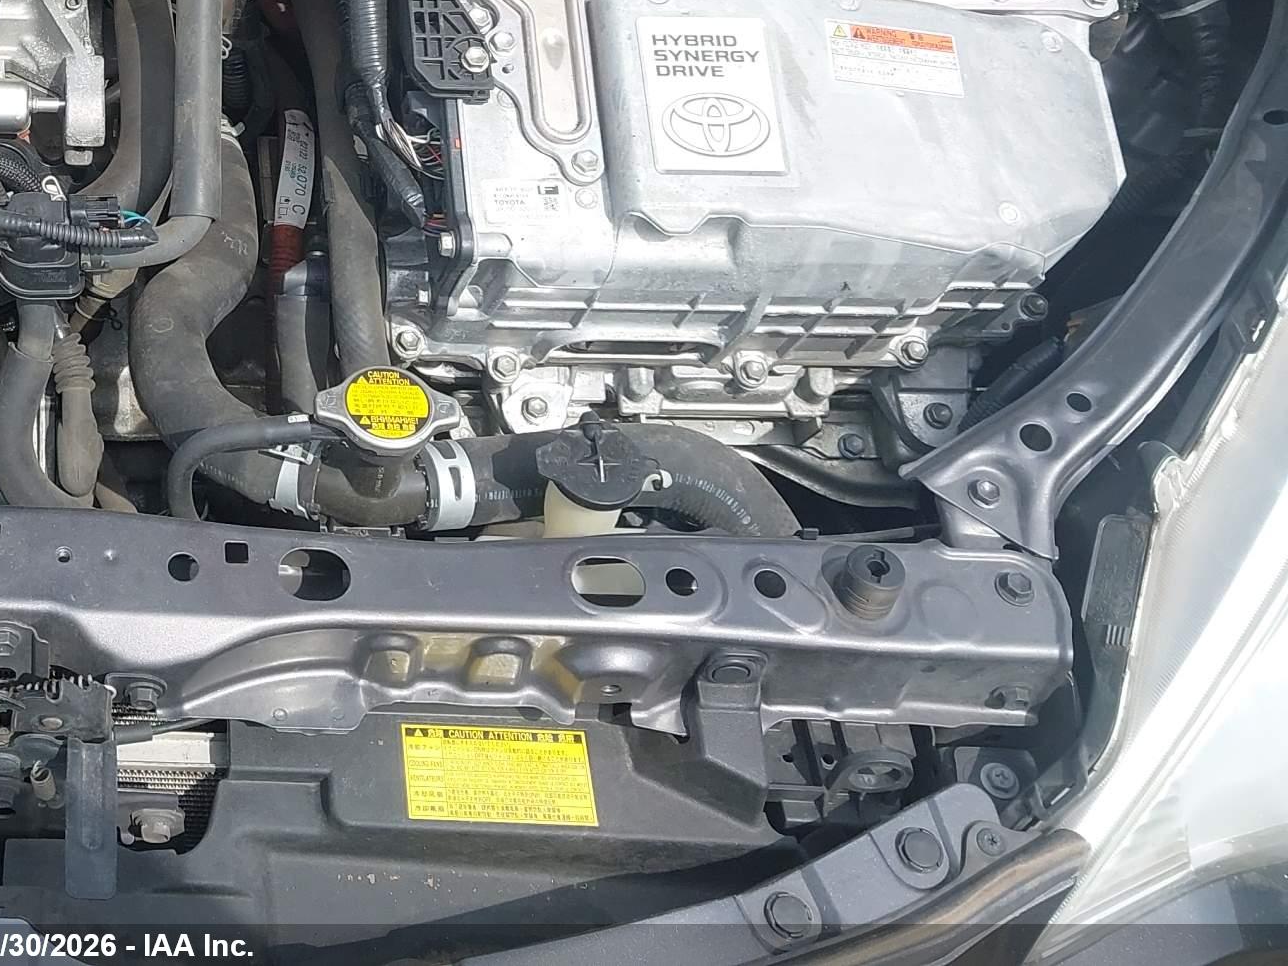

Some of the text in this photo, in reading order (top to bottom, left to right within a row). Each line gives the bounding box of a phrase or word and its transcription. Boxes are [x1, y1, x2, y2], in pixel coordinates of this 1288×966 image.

[651, 34, 737, 47] HYBRID
[653, 49, 759, 63] SYNERGY
[655, 65, 725, 77] DRIVE
[292, 204, 306, 215] C
[367, 370, 400, 378] CAUTION
[368, 378, 410, 386] ATTENTION
[448, 729, 484, 740] CAUTION
[488, 731, 532, 742] ATTENTION
